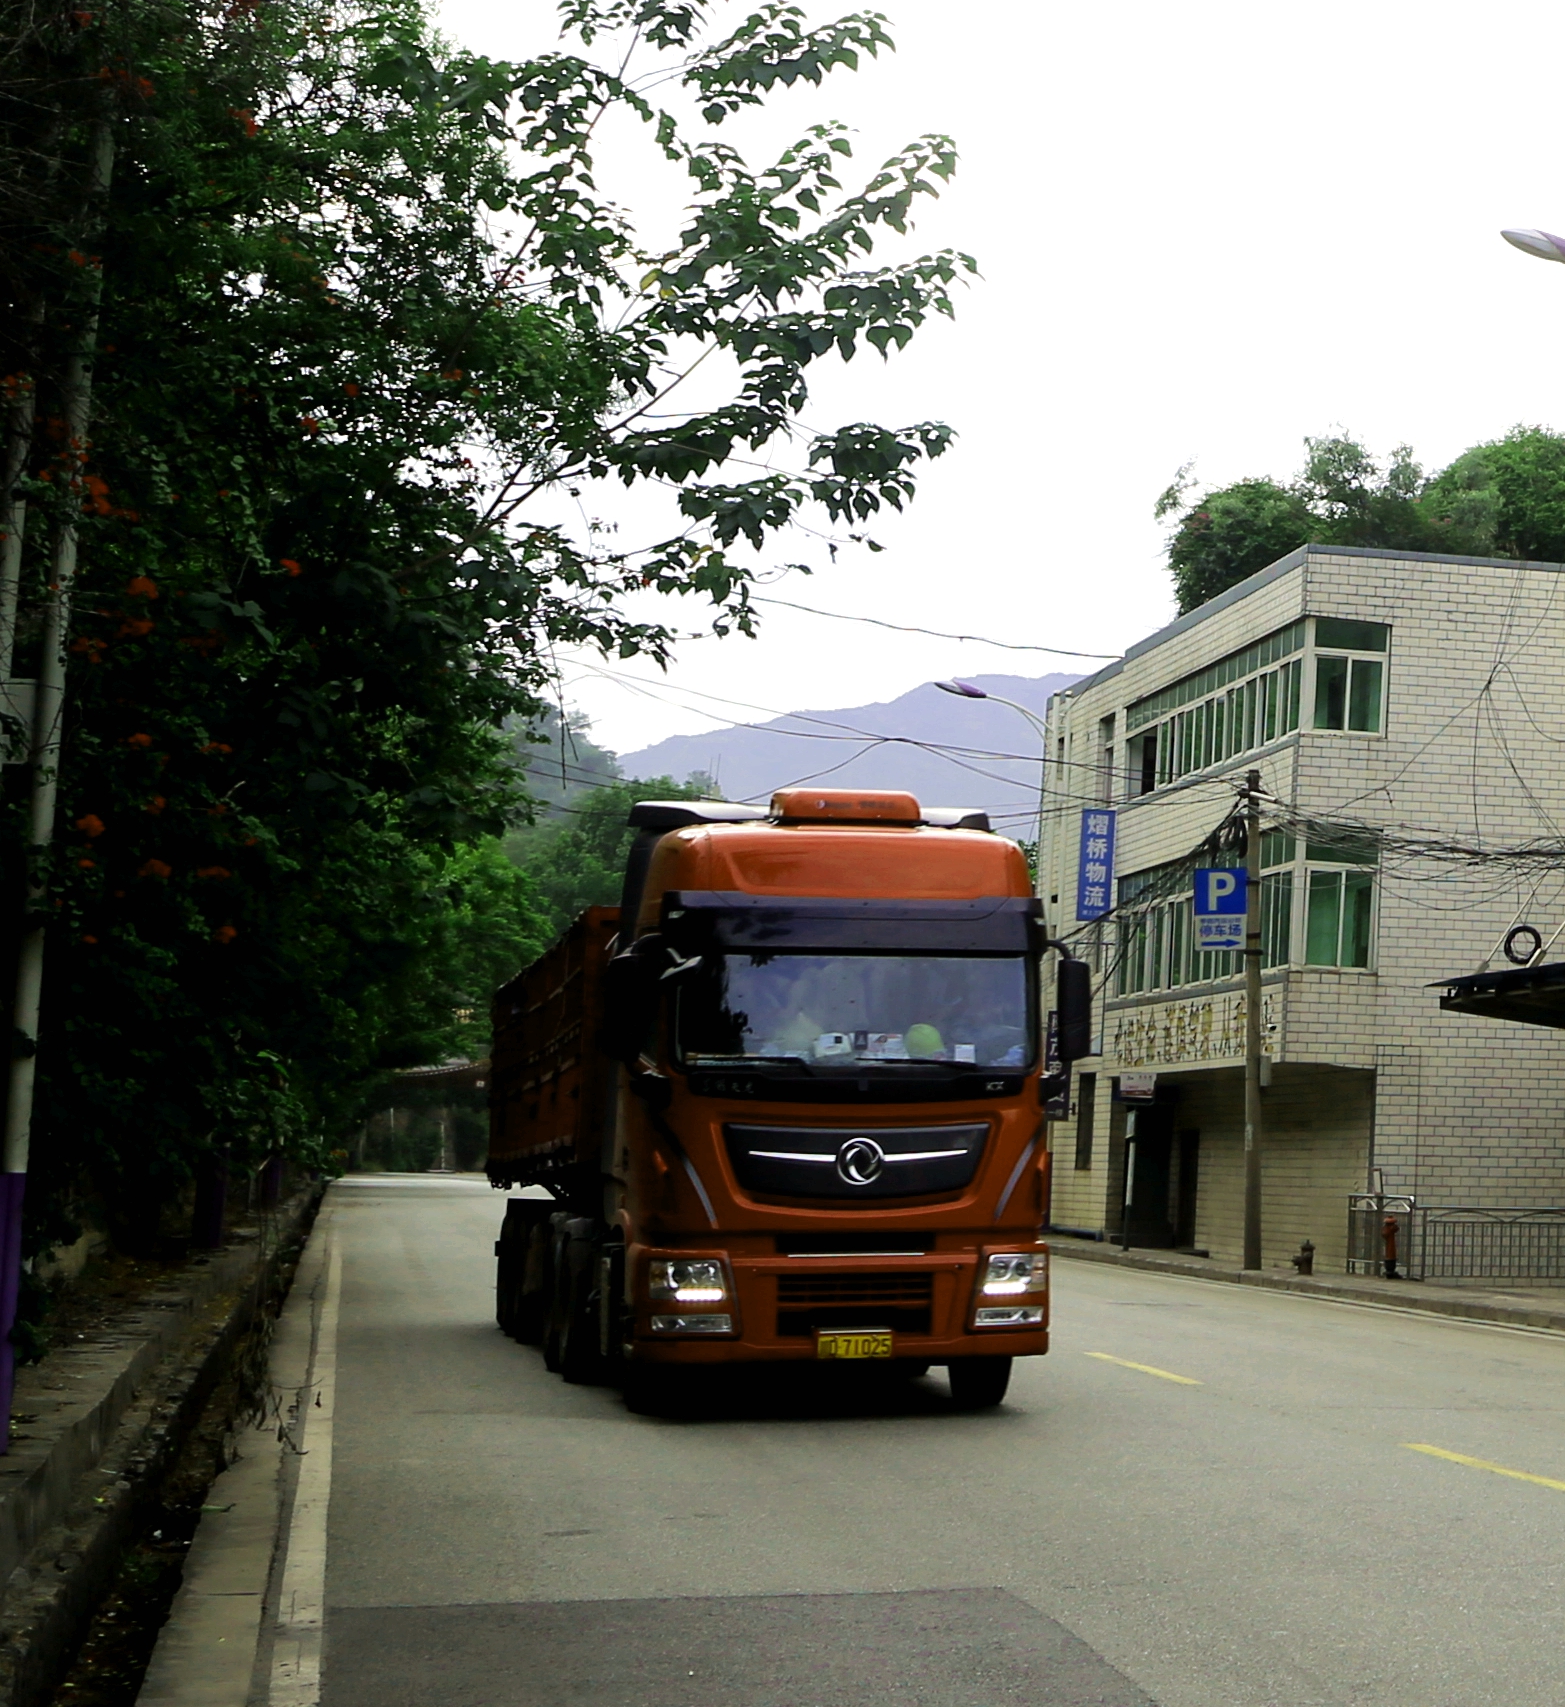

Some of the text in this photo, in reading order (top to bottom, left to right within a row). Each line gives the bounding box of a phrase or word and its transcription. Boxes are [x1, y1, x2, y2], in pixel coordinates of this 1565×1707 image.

[1207, 872, 1236, 911] P
[1200, 924, 1242, 938] 停车场
